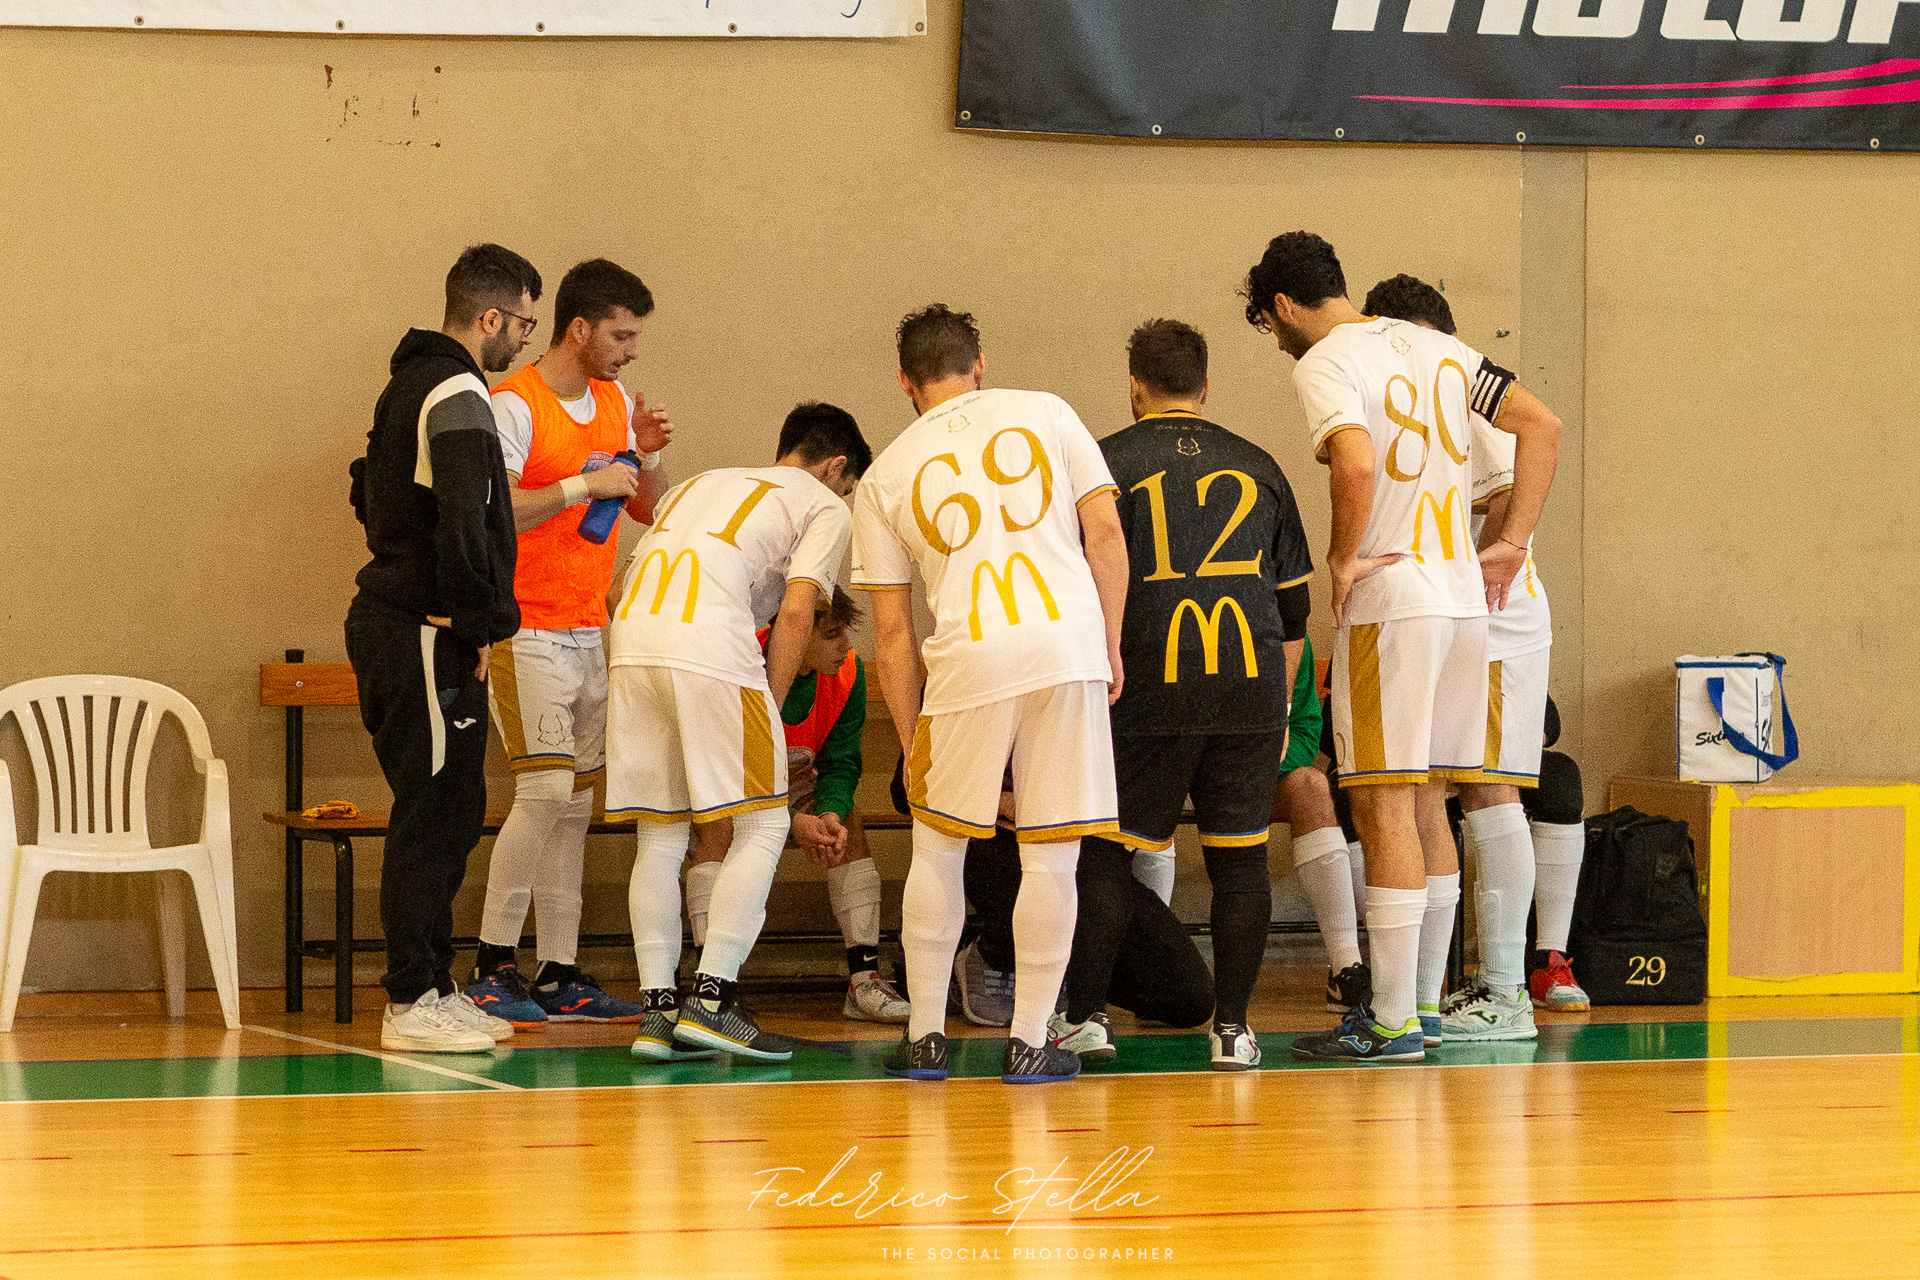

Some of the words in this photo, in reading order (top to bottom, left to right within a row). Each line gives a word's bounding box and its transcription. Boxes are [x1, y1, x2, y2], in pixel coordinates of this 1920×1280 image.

[1385, 358, 1471, 482] 80
[653, 473, 785, 551] 11
[911, 427, 1053, 556] 69
[1130, 469, 1263, 582] 12
[1626, 956, 1667, 986] 29
